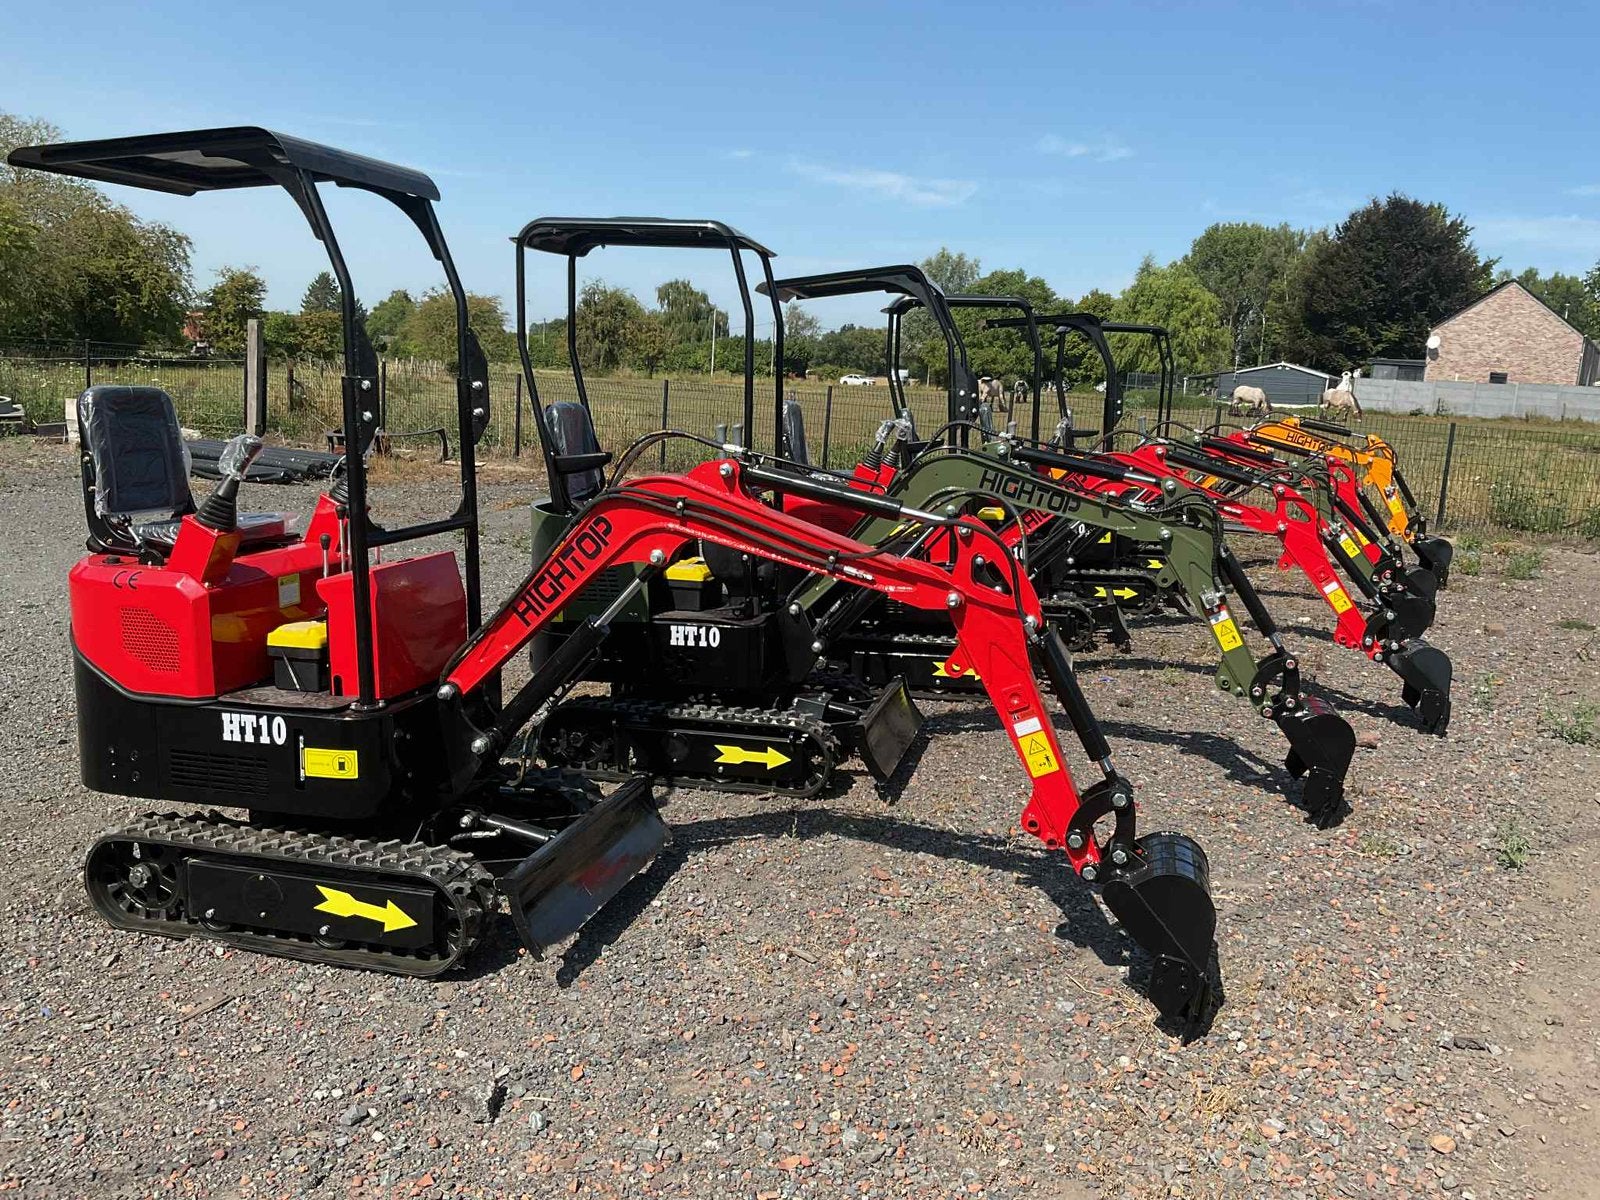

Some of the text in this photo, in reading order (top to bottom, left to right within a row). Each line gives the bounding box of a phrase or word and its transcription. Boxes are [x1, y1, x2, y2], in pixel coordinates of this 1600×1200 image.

[1286, 432, 1330, 452] HIGHTO
[979, 468, 1081, 515] HIGHTOP
[511, 515, 614, 628] HIGHTOP
[670, 625, 721, 648] HT10
[221, 712, 287, 746] HT10
